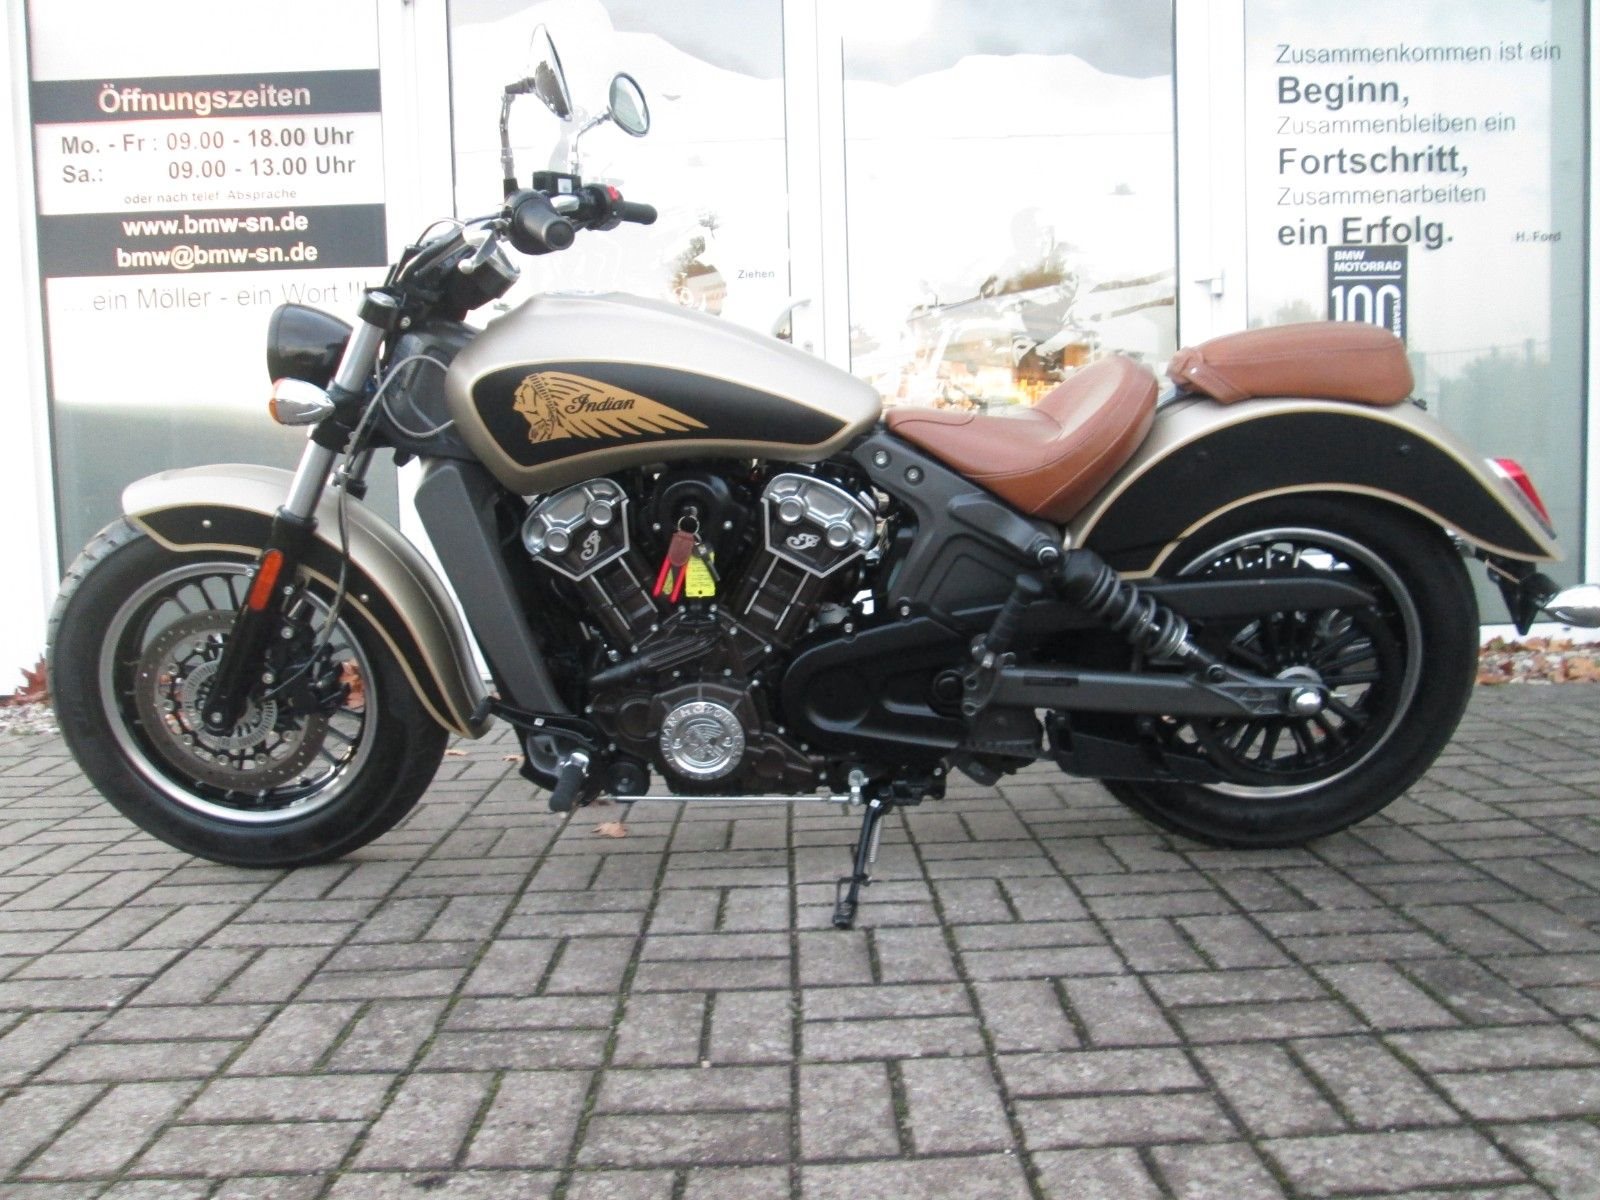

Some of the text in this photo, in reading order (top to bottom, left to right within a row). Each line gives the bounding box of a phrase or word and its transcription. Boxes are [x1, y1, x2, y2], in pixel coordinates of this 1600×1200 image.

[1276, 41, 1561, 65] Zusammenkommen ist ein
[99, 83, 311, 116] Öffnungszeiten
[1278, 75, 1409, 111] Beginn,
[1277, 113, 1515, 135] Zusammenbleiben ein
[61, 136, 100, 154] Mo.
[167, 131, 225, 151] 09.00
[248, 128, 305, 148] 18.00
[314, 126, 354, 146] Uhr
[62, 165, 103, 183] Sa.:
[168, 160, 226, 180] 09.00
[250, 157, 308, 177] 13.00
[316, 156, 356, 175] Uhr
[1278, 144, 1468, 177] Fortschritt,
[124, 194, 153, 204] oder
[157, 192, 188, 203] nach
[228, 189, 297, 201] Absprache
[1277, 184, 1486, 206] Zusammenarbeiten
[122, 211, 309, 236] www.bmw-sn.de
[1278, 216, 1453, 250] ein Erfolg.
[1533, 231, 1561, 242] Ford
[117, 242, 318, 270] bmw@bmw-sn.de
[1333, 261, 1402, 272] MOTORRAD
[1334, 250, 1365, 261] BMW
[738, 269, 775, 279] Ziehen
[93, 289, 127, 311] ein
[138, 286, 210, 310] Möller
[237, 285, 271, 306] ein
[281, 281, 338, 304] Wort
[565, 393, 635, 415] Indian
